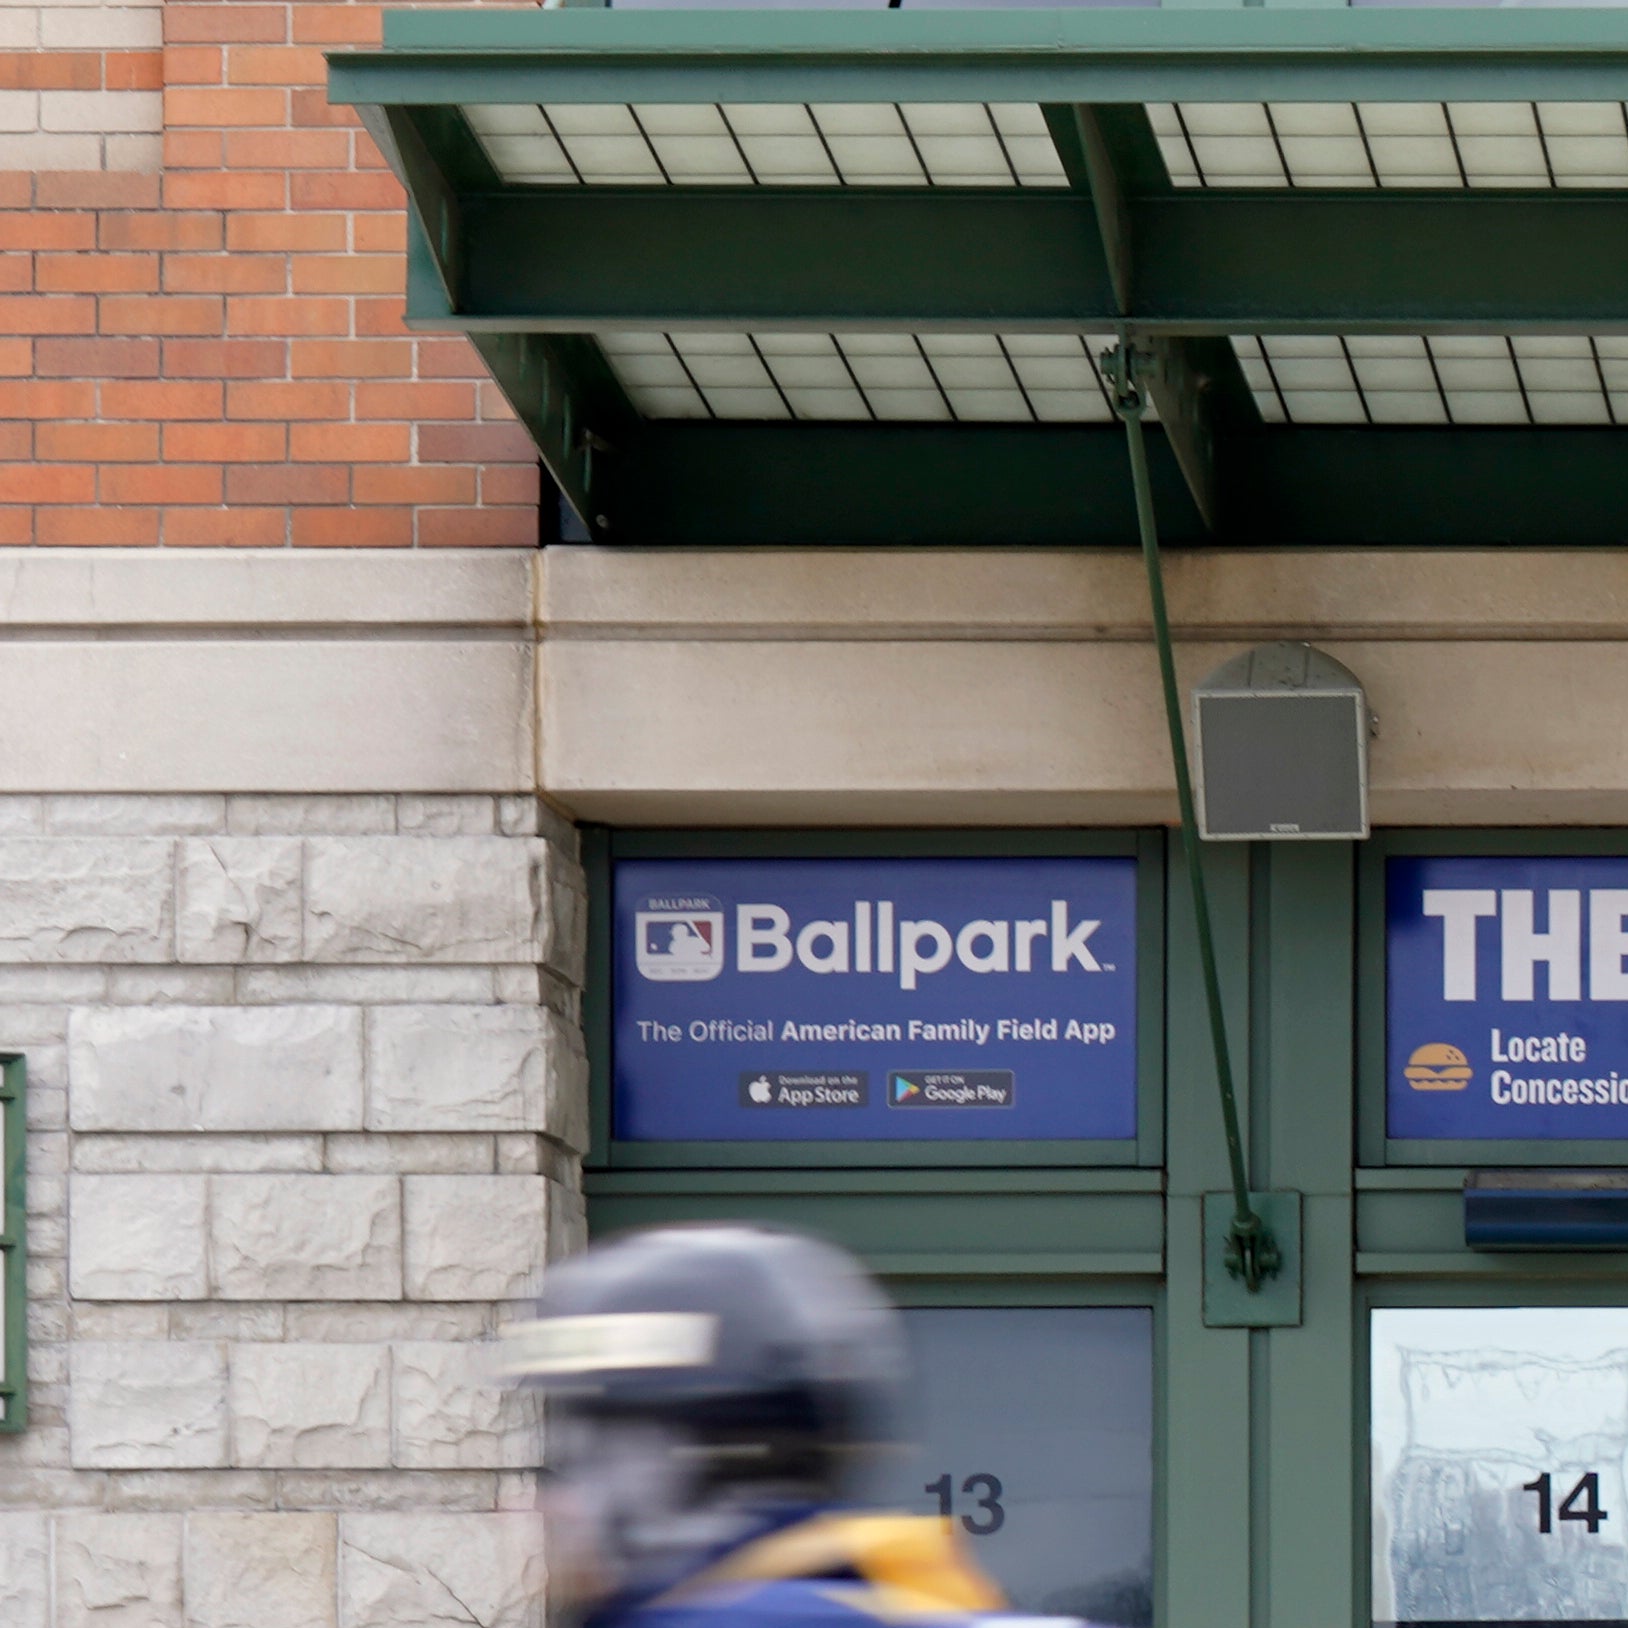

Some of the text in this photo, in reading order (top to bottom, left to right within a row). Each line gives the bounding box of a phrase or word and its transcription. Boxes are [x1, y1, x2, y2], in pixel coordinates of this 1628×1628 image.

[649, 898, 710, 910] BALLPARK
[637, 1019, 1116, 1046] The Official American Family Field App
[1490, 1028, 1587, 1063] Locate
[778, 1086, 860, 1106] App Store
[925, 1085, 1008, 1105] Google Play
[925, 1473, 1005, 1536] 13
[1523, 1472, 1608, 1534] 14
